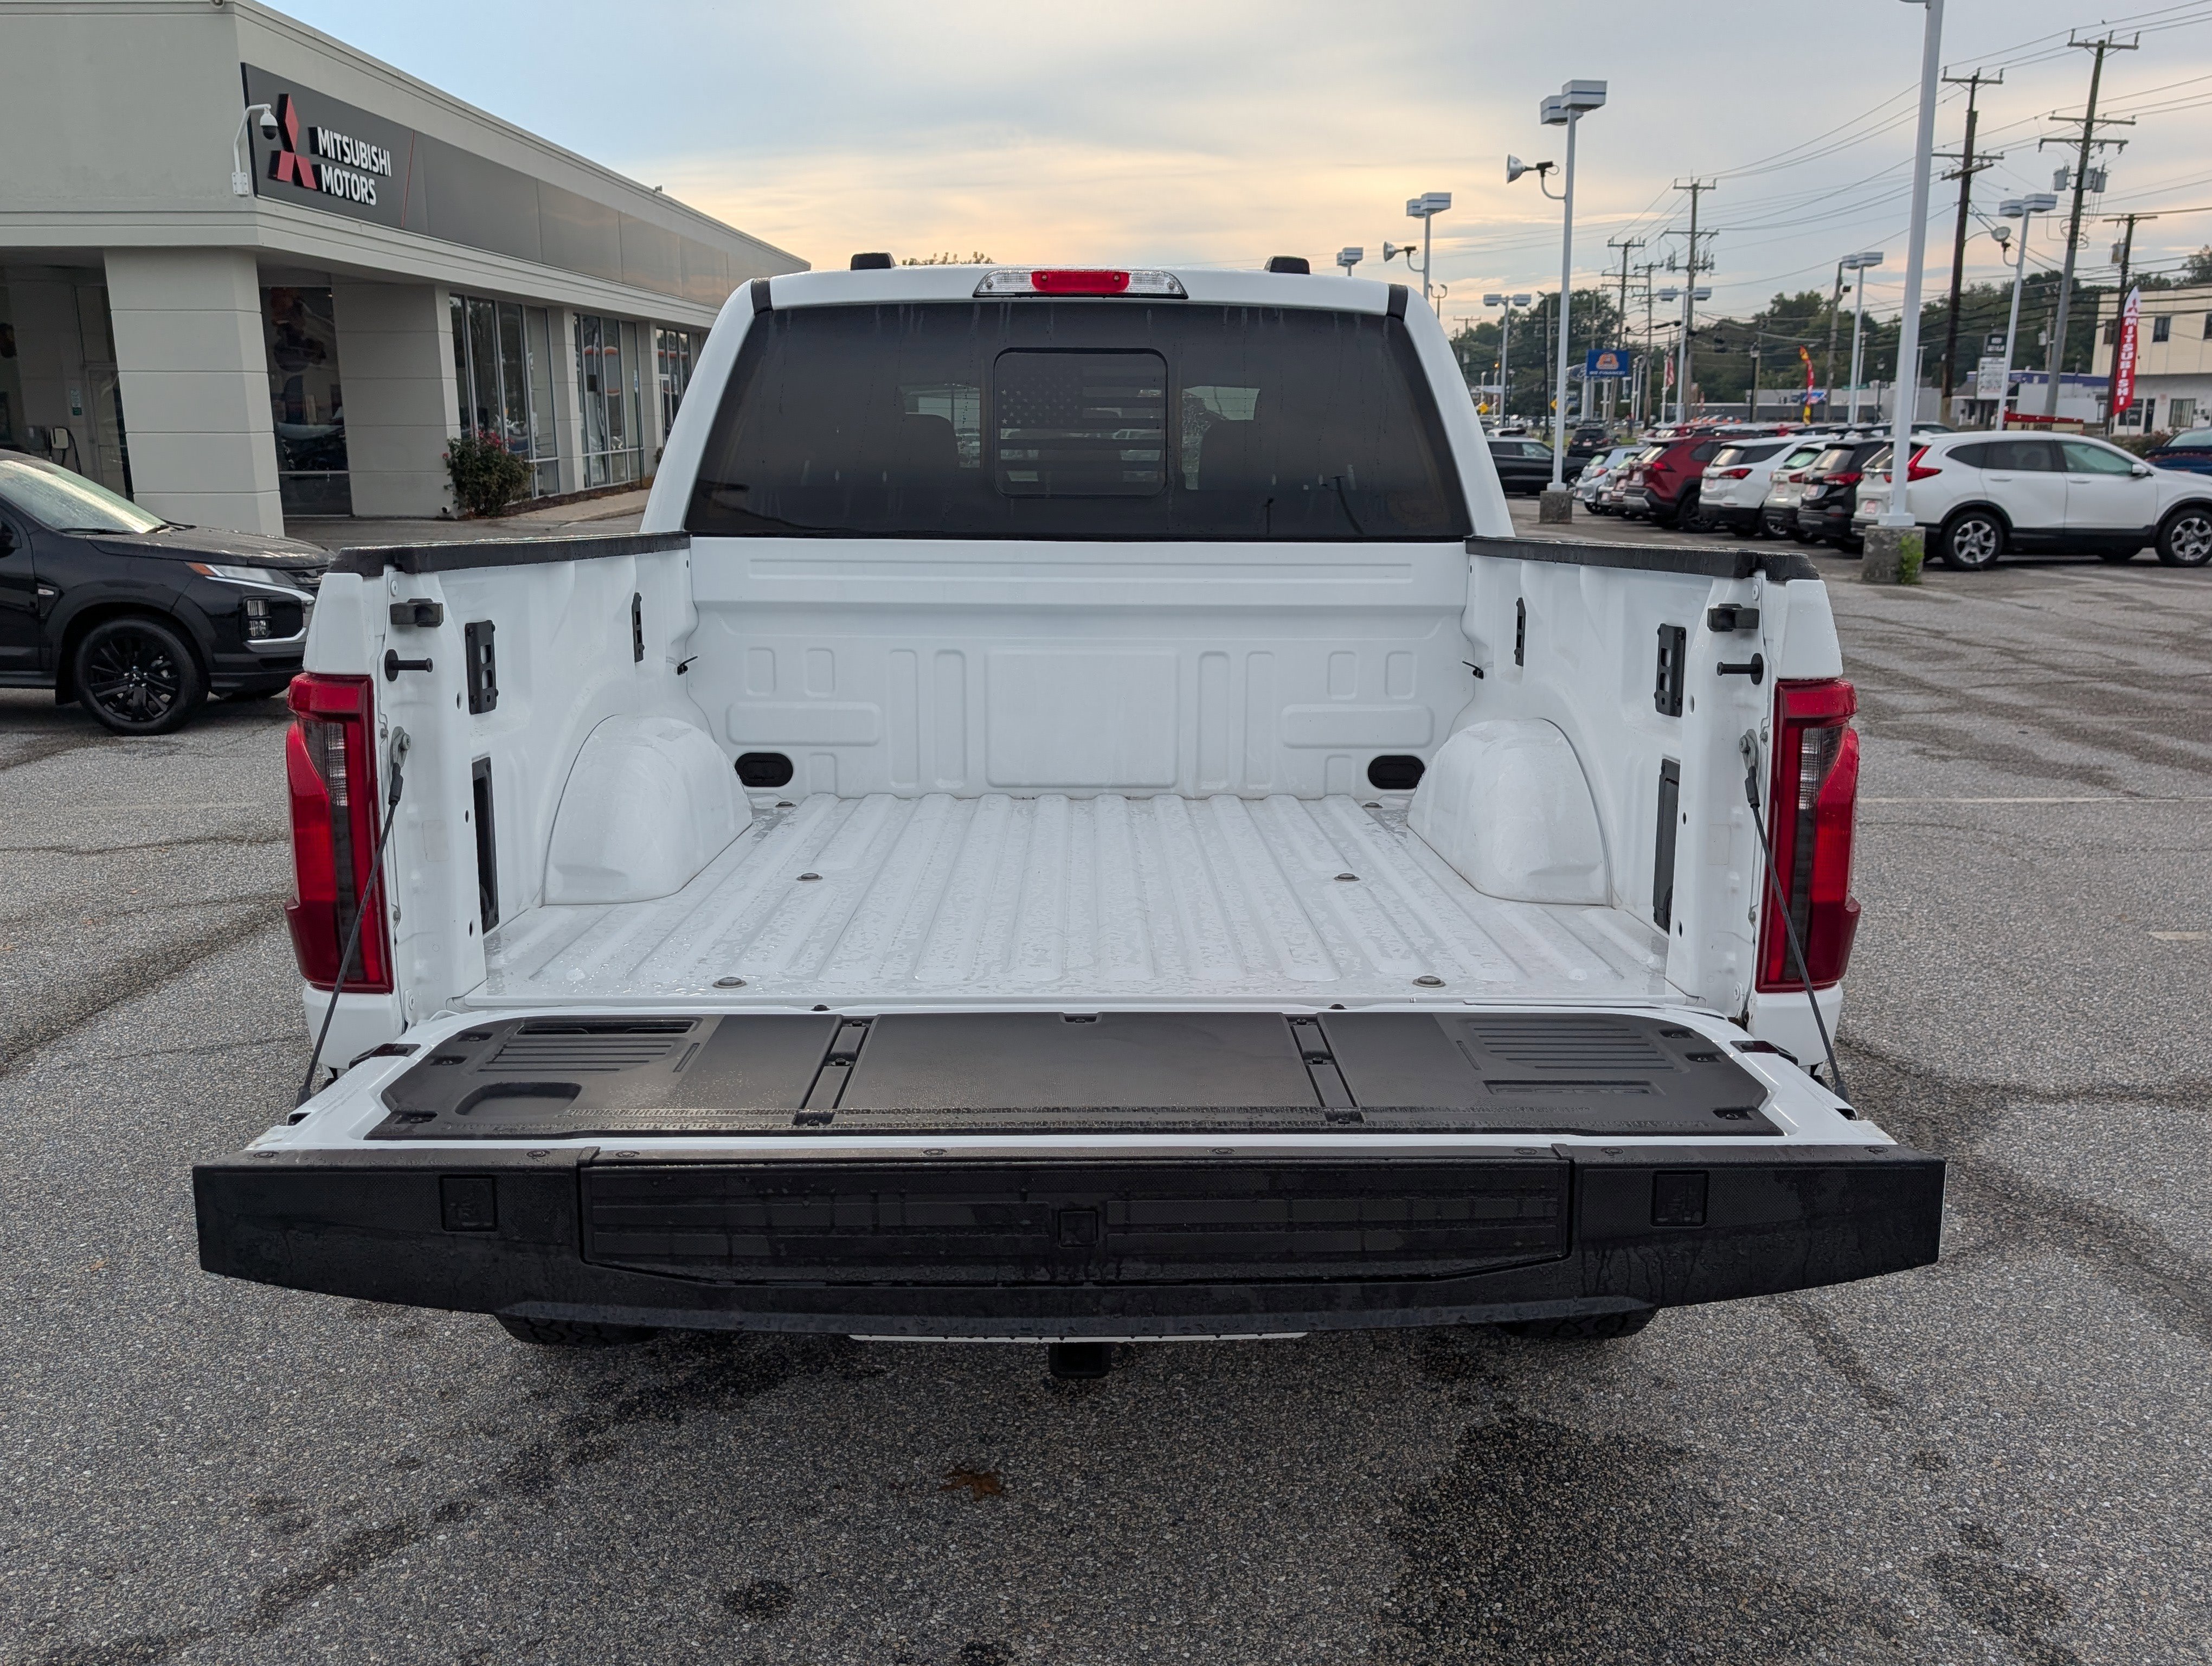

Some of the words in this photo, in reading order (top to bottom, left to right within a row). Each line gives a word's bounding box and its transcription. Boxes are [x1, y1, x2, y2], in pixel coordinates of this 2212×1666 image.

[317, 126, 391, 177] MITSUBISHI
[321, 164, 376, 206] MOTORS
[2117, 317, 2137, 406] MITSUBISHI
